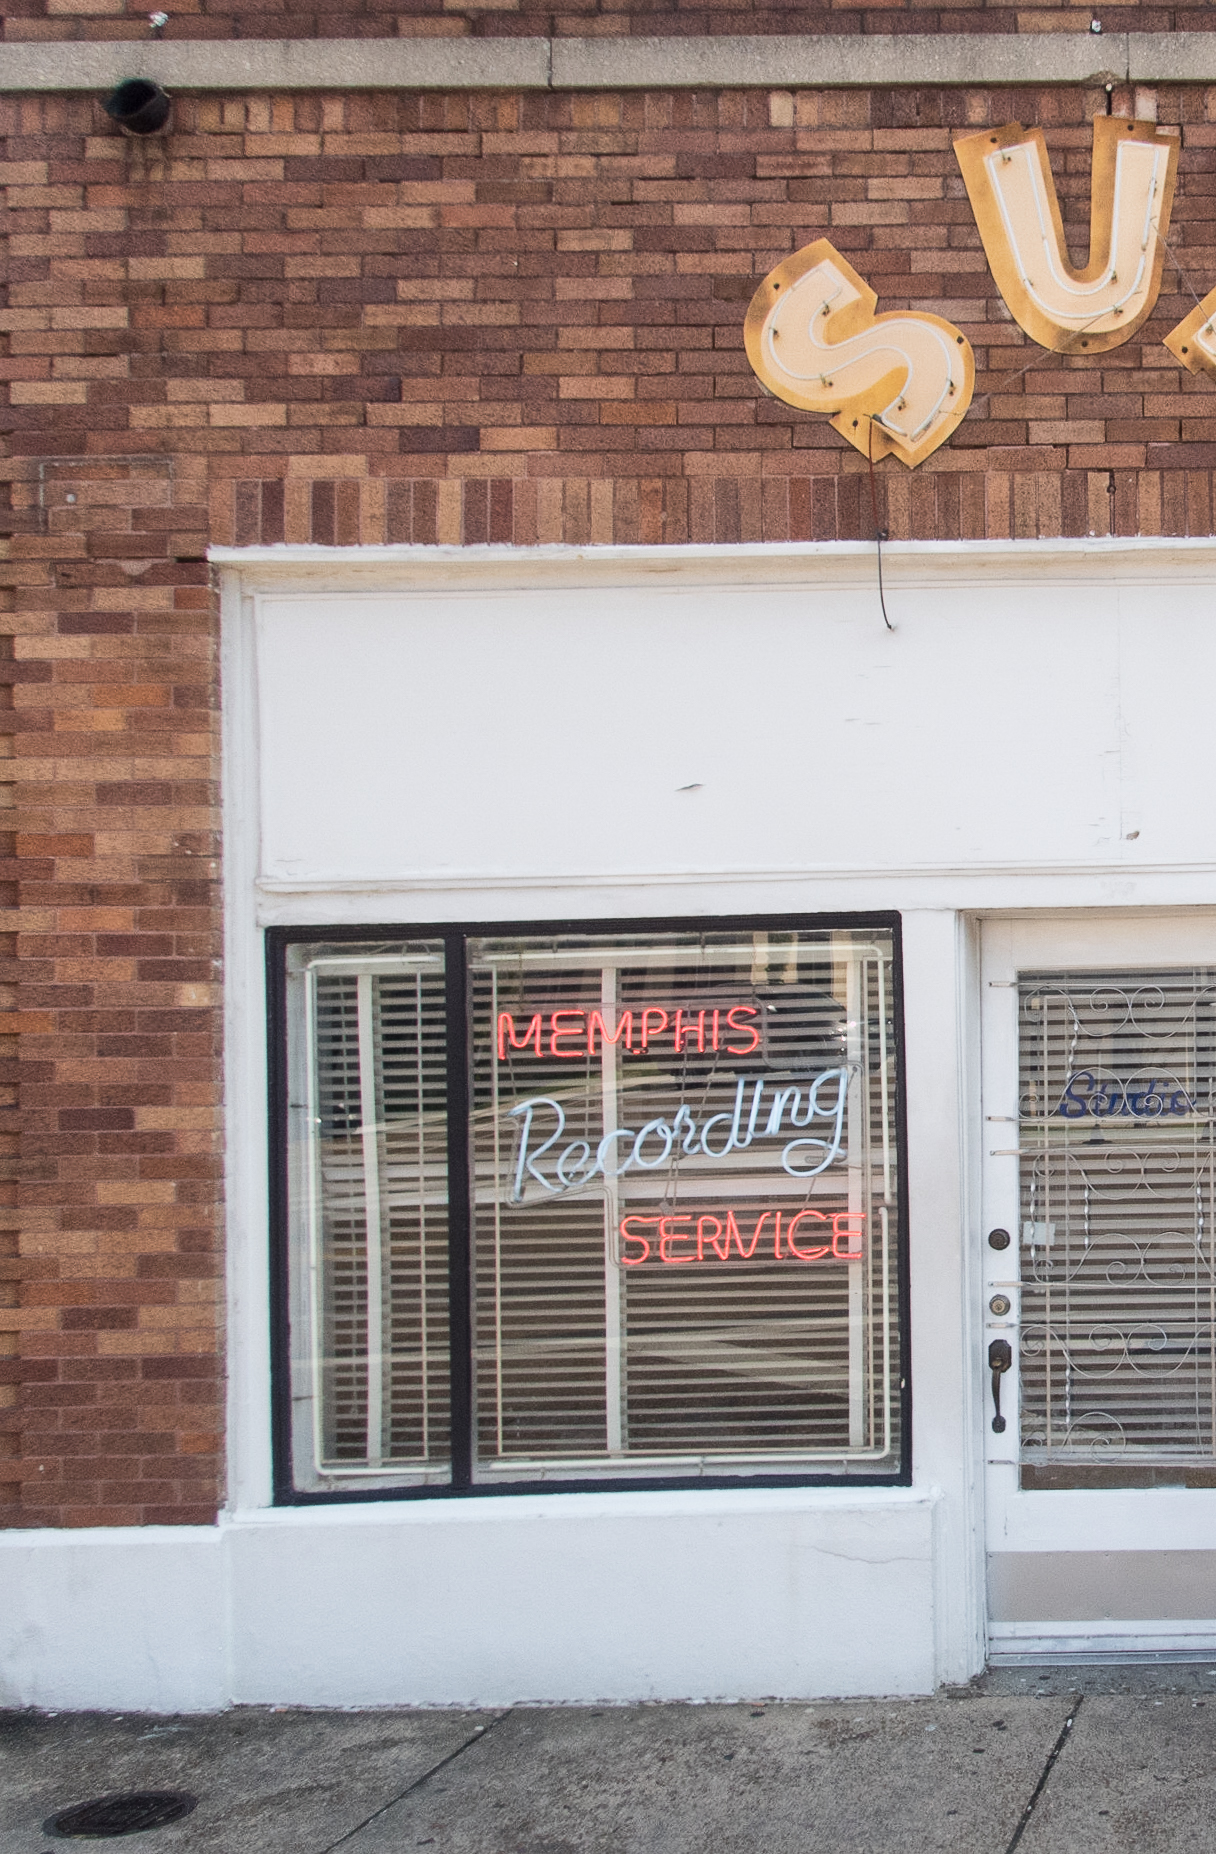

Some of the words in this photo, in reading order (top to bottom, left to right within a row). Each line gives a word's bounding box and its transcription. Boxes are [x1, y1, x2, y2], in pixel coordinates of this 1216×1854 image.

[497, 1004, 761, 1061] MEMPHIS
[1059, 1071, 1197, 1119] Studio
[506, 1066, 848, 1202] Recording
[619, 1209, 867, 1265] SERVICE
